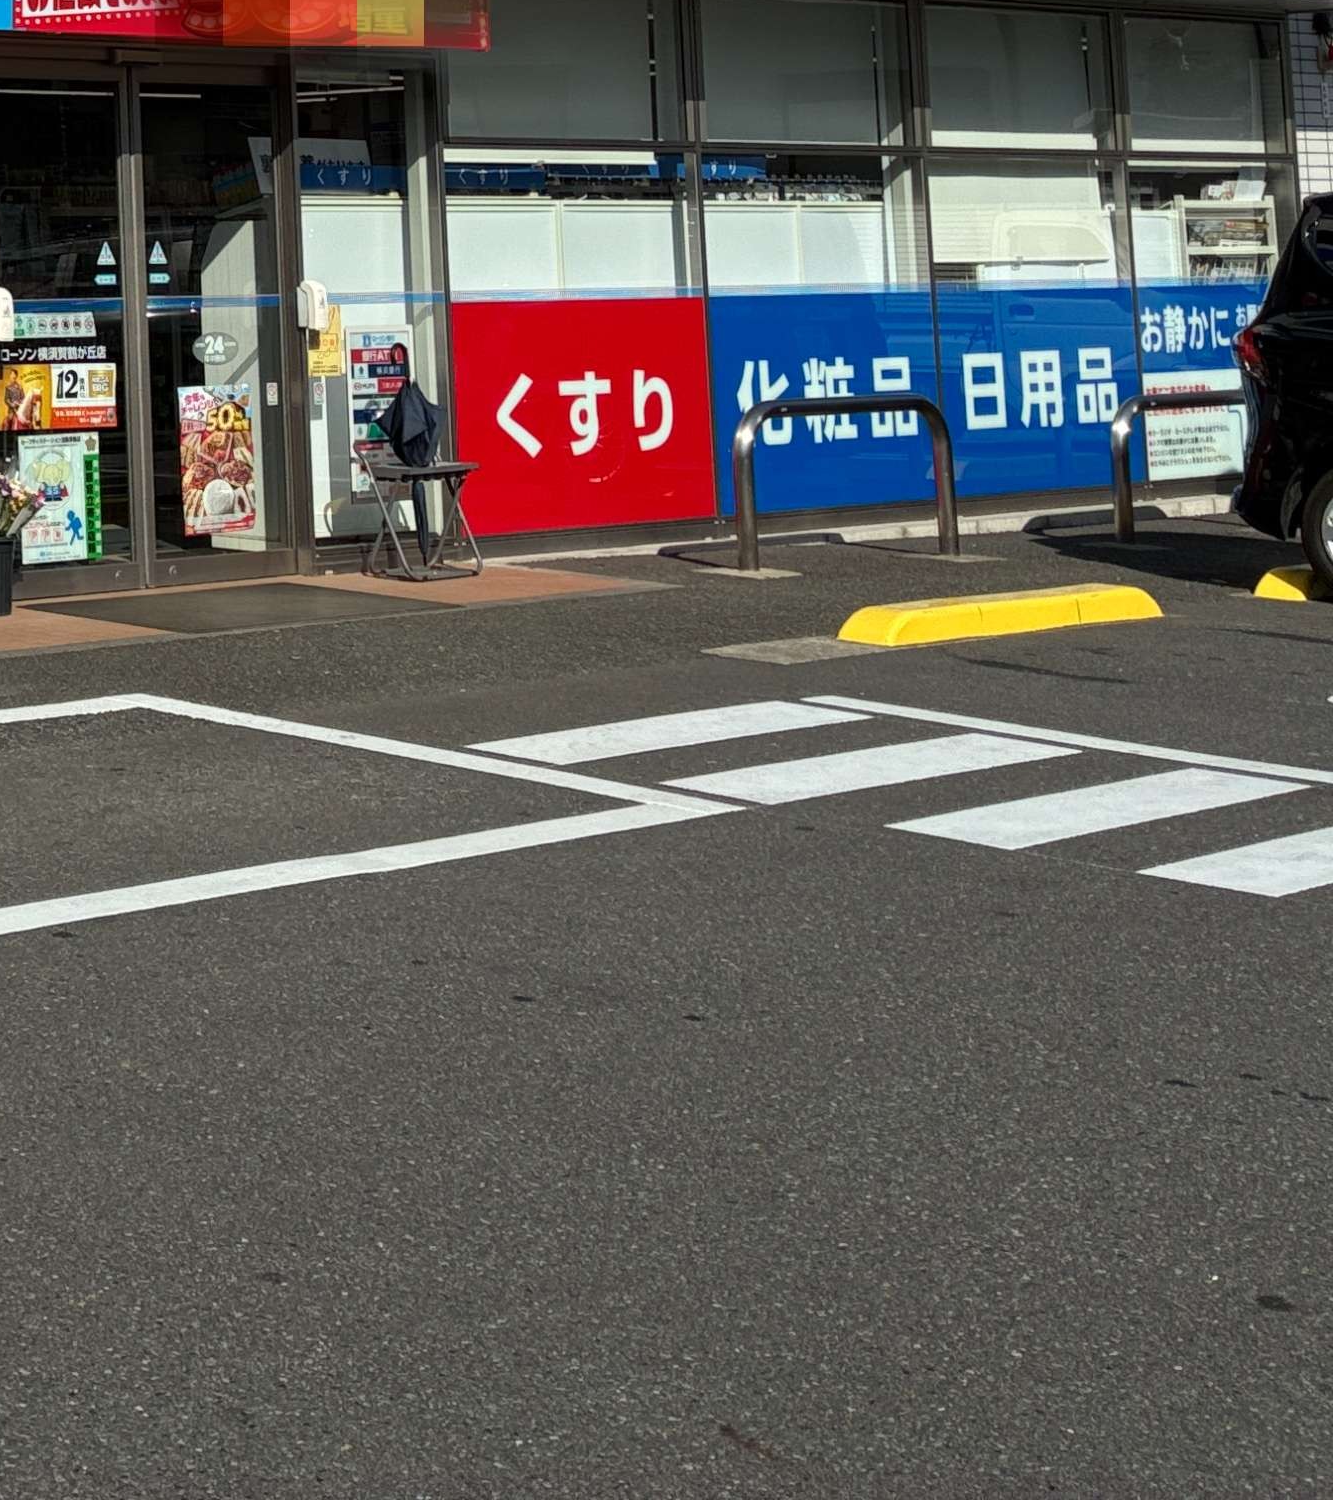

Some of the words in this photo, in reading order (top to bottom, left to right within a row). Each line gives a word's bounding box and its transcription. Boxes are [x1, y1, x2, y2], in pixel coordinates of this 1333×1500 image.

[316, 168, 372, 186] くすり
[458, 168, 509, 186] くすり
[204, 335, 225, 354] 24
[1141, 304, 1231, 353] お静かに
[56, 369, 79, 399] 12
[736, 355, 919, 447] 化粧品
[962, 346, 1119, 432] 日用品
[496, 367, 675, 458] くすり
